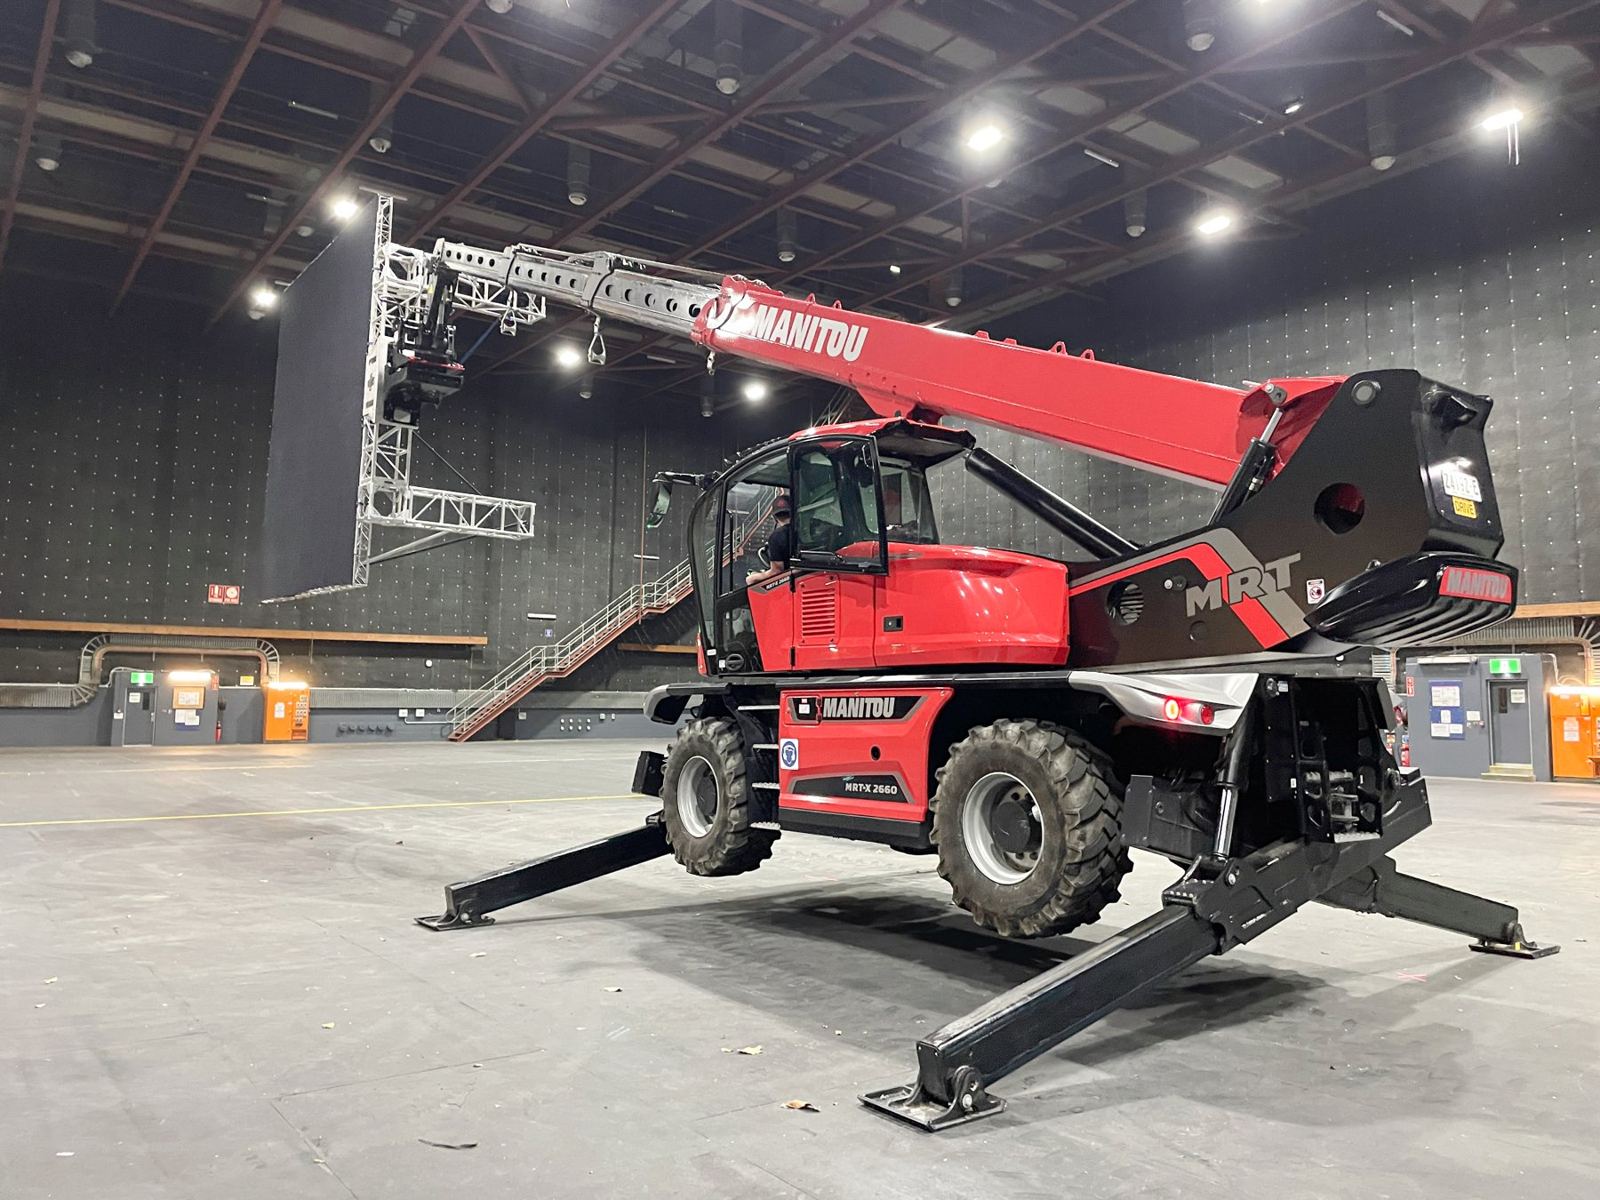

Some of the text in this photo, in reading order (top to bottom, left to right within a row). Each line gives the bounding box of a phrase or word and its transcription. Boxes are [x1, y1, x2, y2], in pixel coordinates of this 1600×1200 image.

[750, 304, 869, 362] MANITOU
[1186, 553, 1301, 618] MRT
[1446, 567, 1508, 599] MANITOU
[823, 697, 896, 718] MANITOU
[872, 784, 898, 795] 2660
